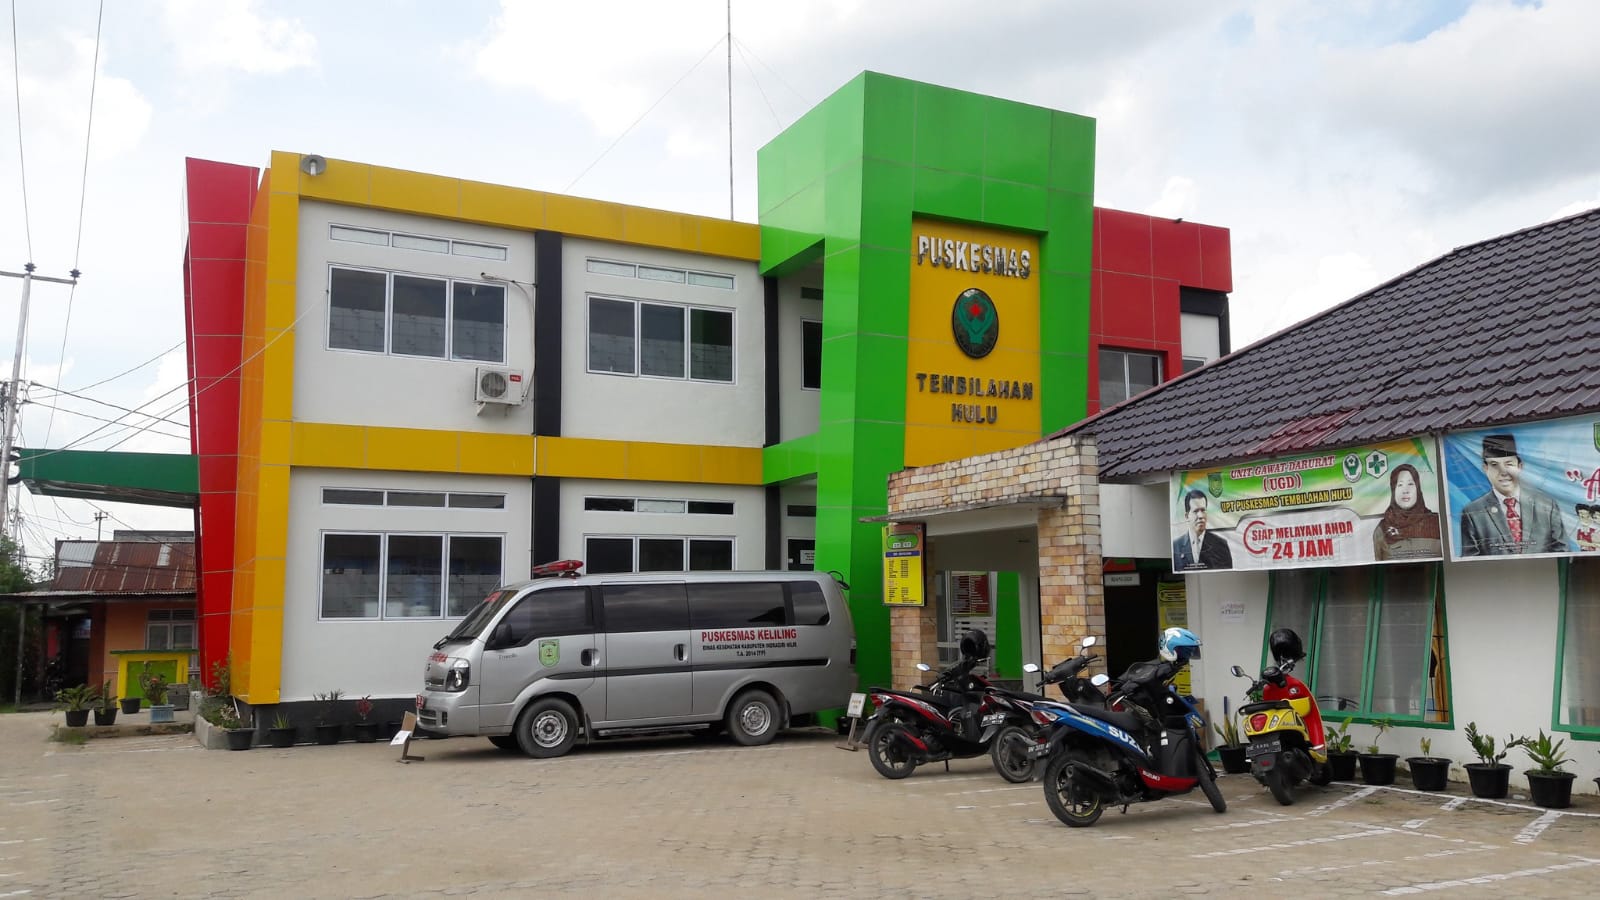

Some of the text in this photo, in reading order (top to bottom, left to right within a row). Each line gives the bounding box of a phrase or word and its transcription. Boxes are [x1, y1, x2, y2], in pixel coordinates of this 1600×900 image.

[917, 235, 1031, 279] PUSKESMAS
[916, 373, 1034, 400] TEMBILAHAN
[951, 403, 998, 424] HULU
[1230, 456, 1335, 479] UNIT GAWAT DARURAT
[1263, 474, 1302, 492] (UGD)
[1221, 487, 1353, 513] UPT PUSKESMAS TEMBILAHAN HULU
[1252, 521, 1354, 541] SIAP MELAYANI ANDA
[1272, 538, 1334, 560] 24 JAM
[702, 628, 797, 642] PUSKESMAS KELILING
